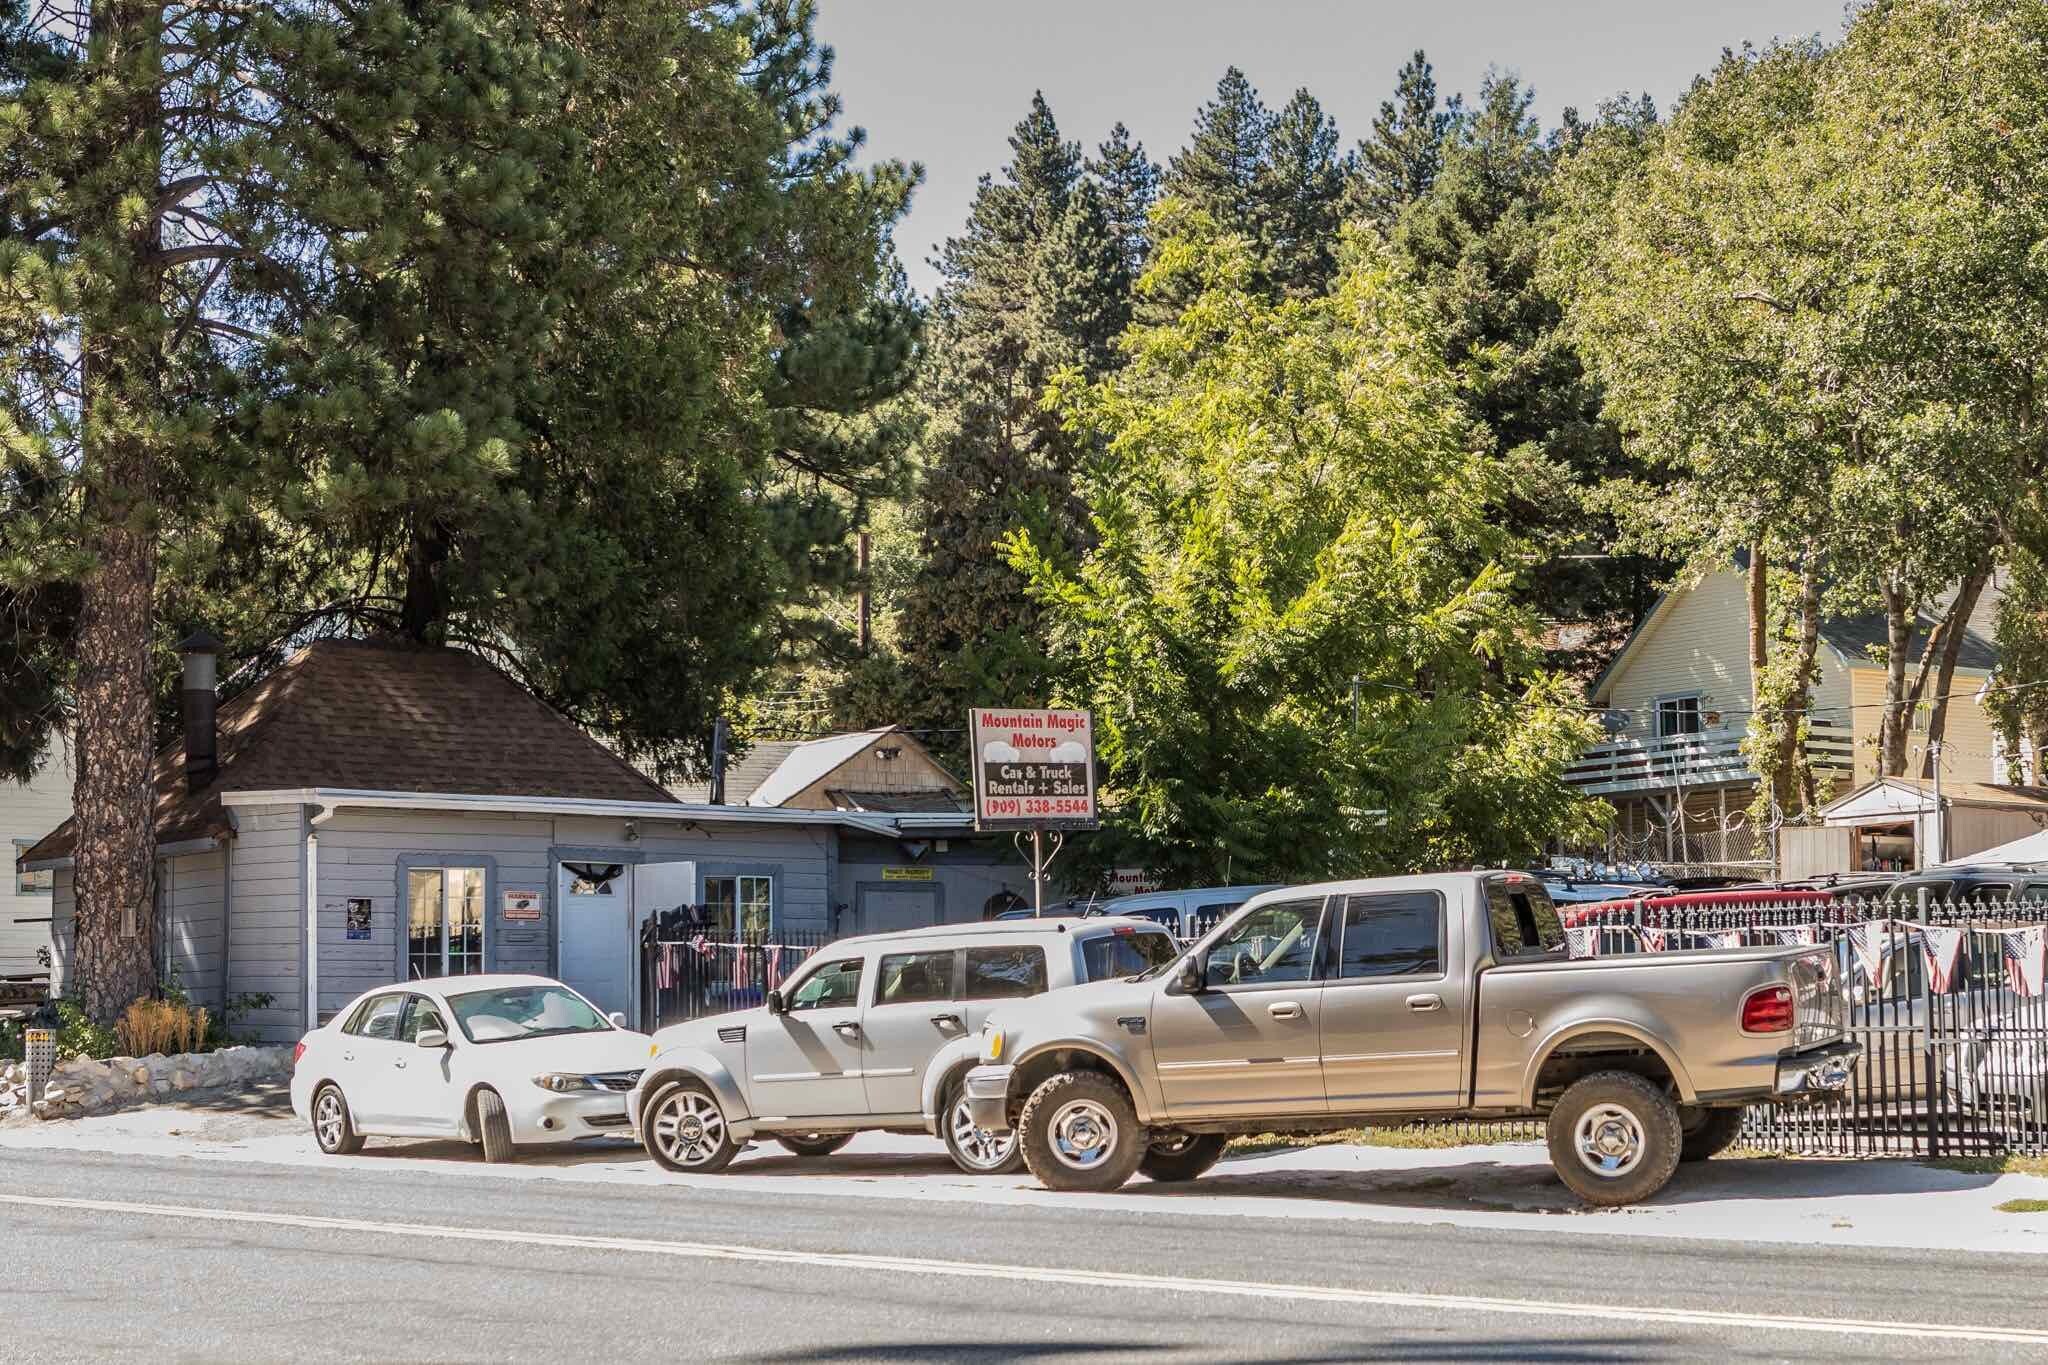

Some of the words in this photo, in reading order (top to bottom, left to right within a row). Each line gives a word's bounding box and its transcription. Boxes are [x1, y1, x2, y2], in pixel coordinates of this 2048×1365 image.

[982, 713, 1043, 728] Mountain
[1047, 714, 1086, 732] Magic
[1012, 733, 1057, 748] Motors
[1001, 765, 1023, 780] Car
[1026, 766, 1036, 779] &
[1041, 766, 1072, 779] Truck
[989, 781, 1035, 795] Rentals
[1053, 782, 1085, 795] Sales
[986, 800, 1021, 816] (909)
[1026, 800, 1089, 813] 338-5544
